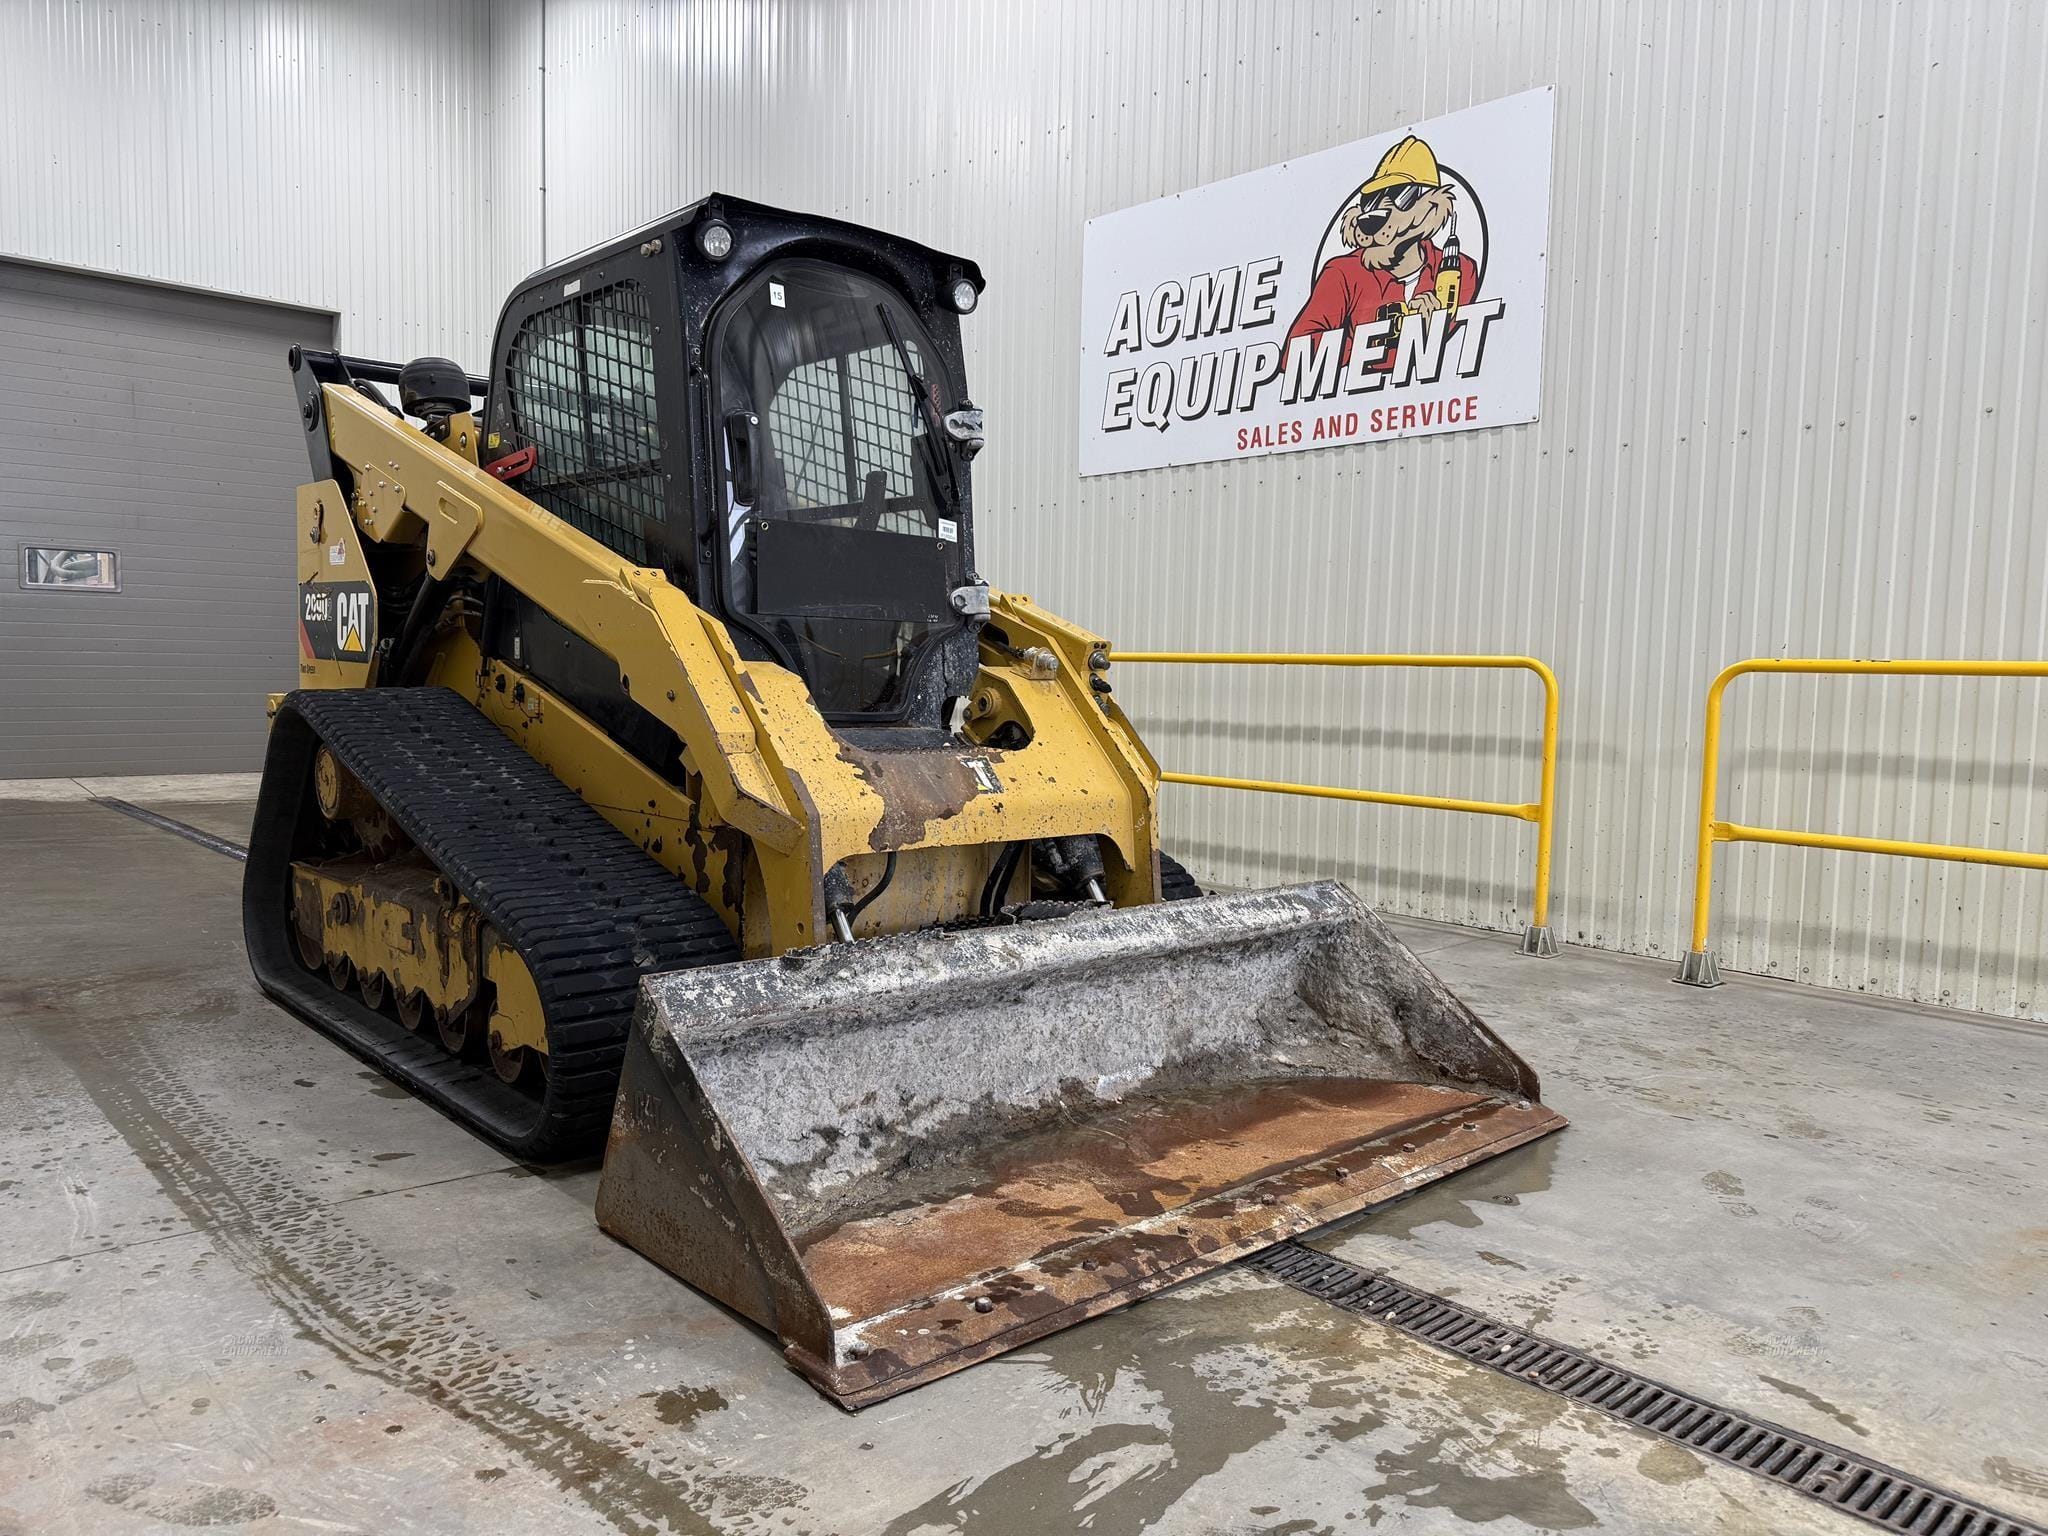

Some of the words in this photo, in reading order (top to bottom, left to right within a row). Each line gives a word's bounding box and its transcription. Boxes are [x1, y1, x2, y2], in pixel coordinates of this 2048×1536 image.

[773, 291, 783, 301] 15
[1104, 256, 1283, 357] ACME
[1102, 298, 1506, 433] EQUIPMENT
[1237, 420, 1302, 450] SALES
[1312, 412, 1358, 440] AND
[1370, 396, 1478, 433] SERVICE
[336, 592, 369, 652] CAT
